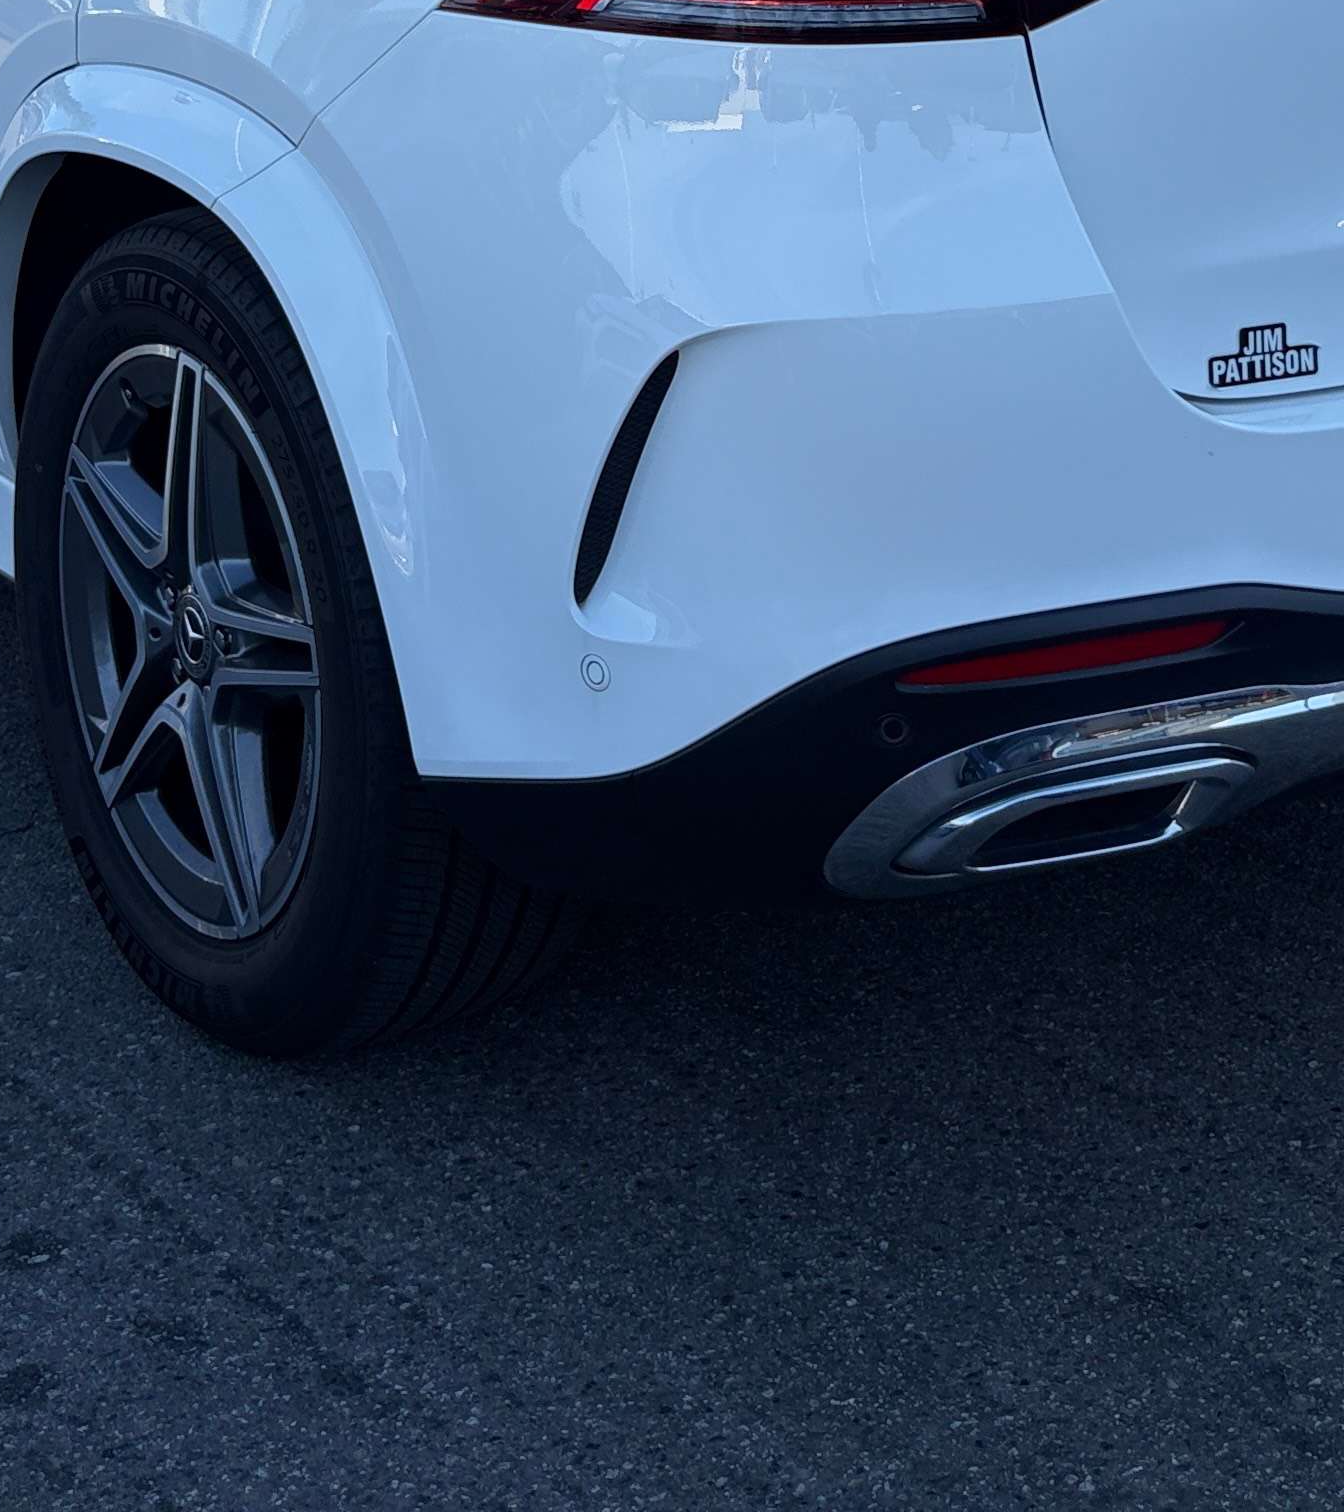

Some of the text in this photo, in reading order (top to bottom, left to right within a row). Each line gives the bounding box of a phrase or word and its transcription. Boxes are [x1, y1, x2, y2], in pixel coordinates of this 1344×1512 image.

[126, 273, 262, 406] MICHELIN
[1244, 327, 1283, 355] JIM
[1212, 348, 1315, 385] PATTISON
